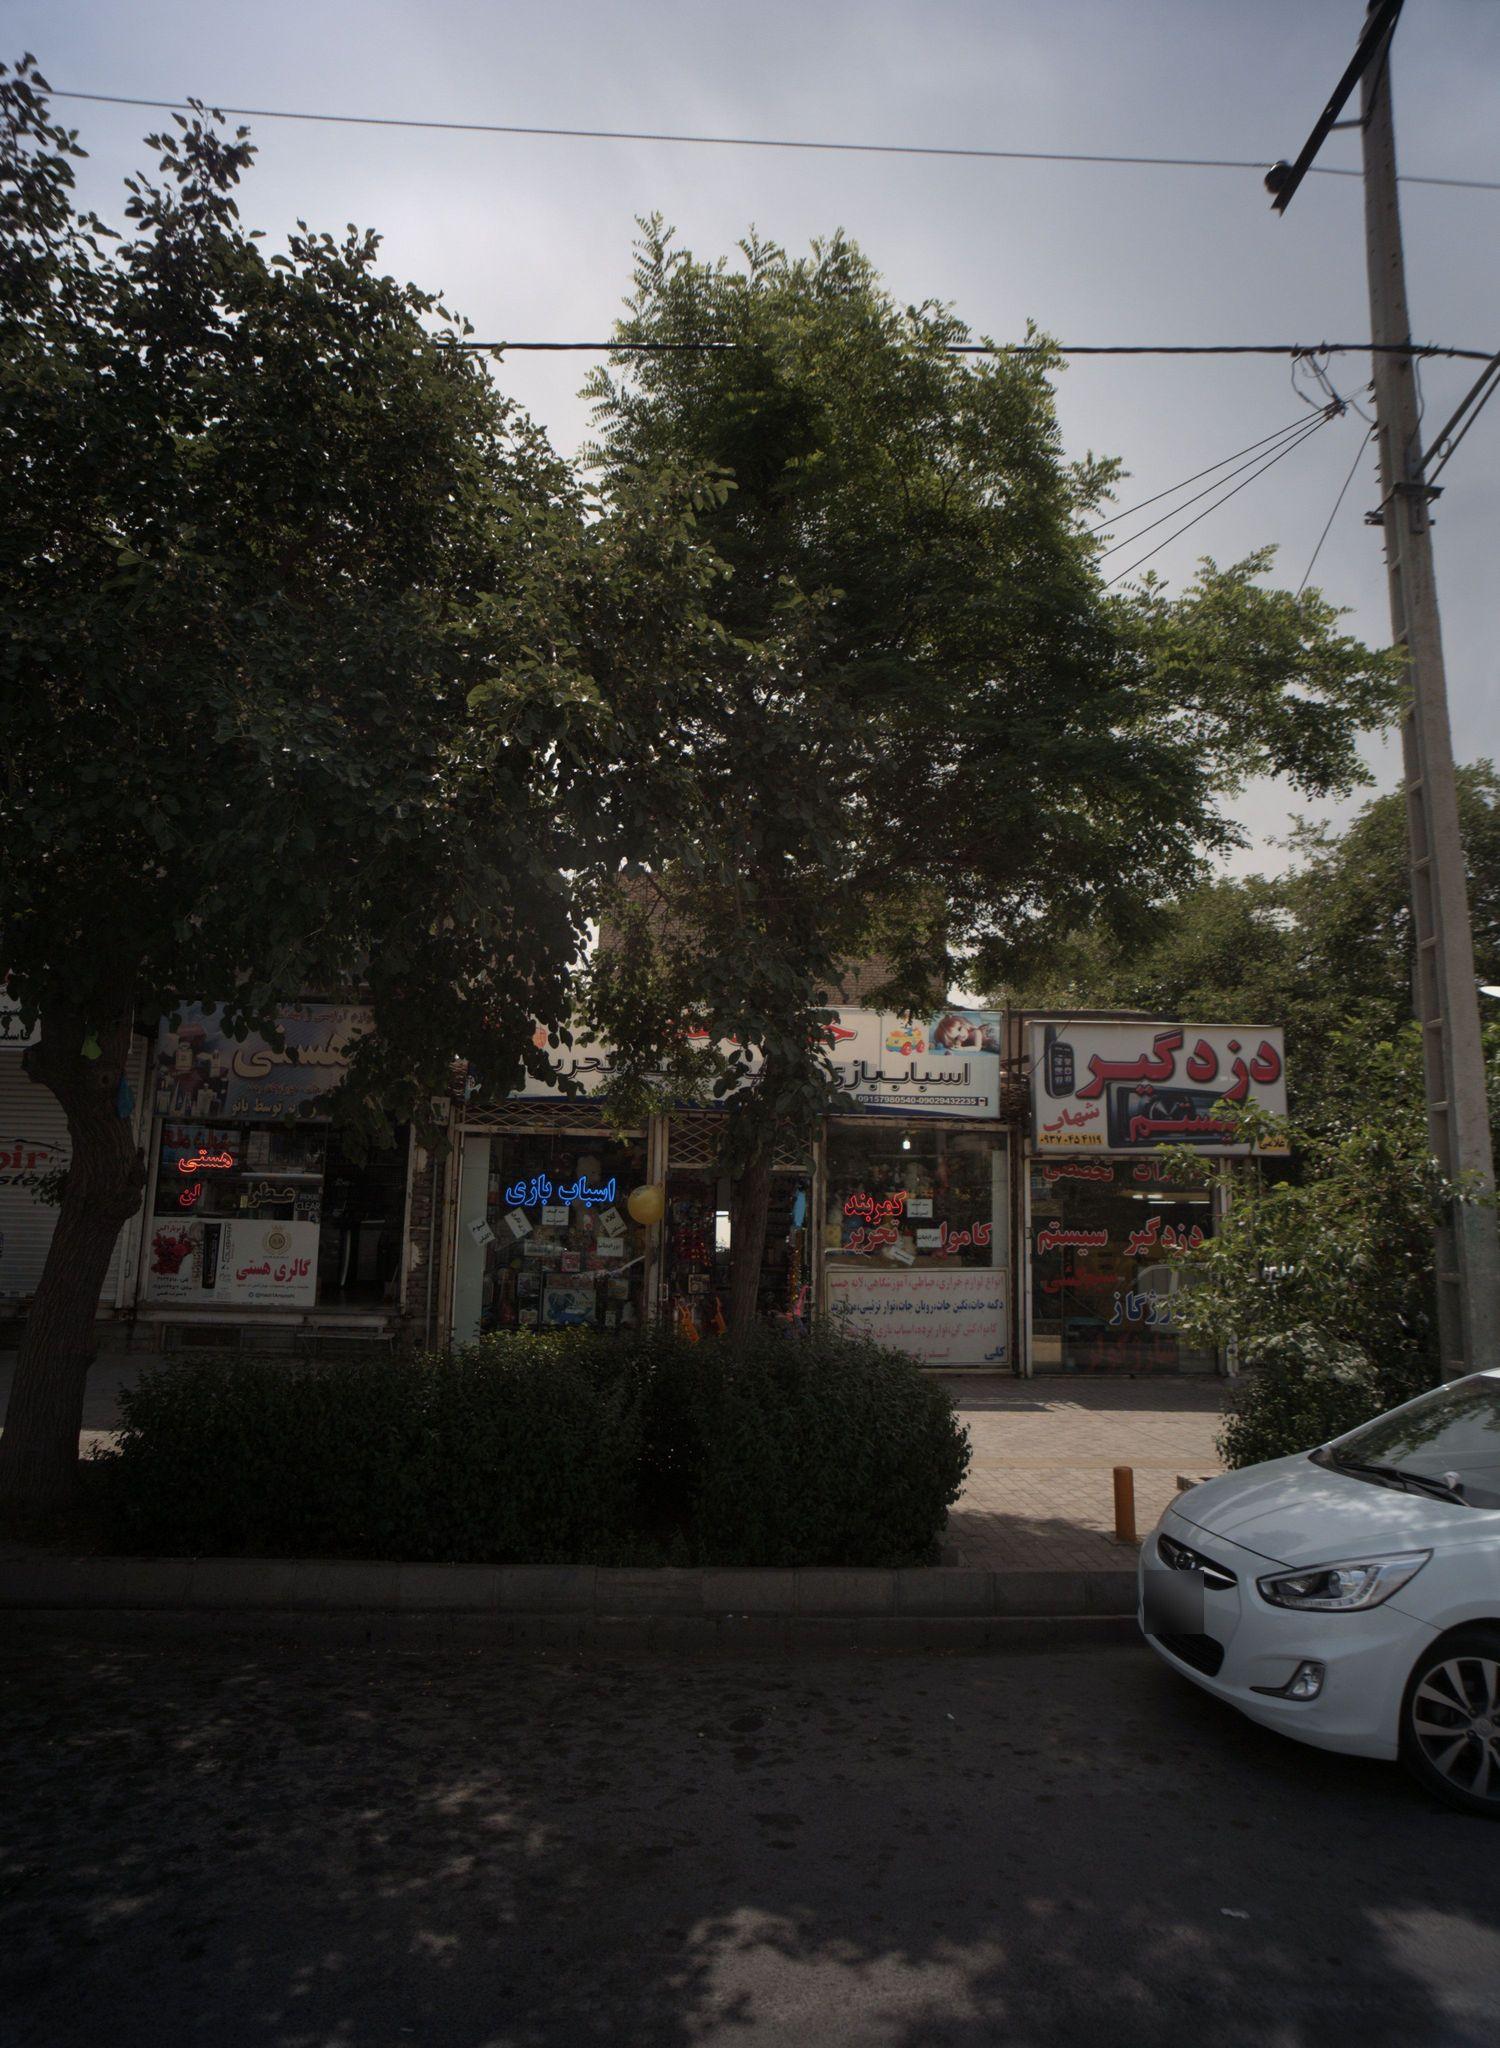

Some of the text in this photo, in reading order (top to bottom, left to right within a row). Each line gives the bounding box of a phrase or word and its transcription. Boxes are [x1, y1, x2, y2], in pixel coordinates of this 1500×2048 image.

[1075, 1028, 1282, 1100] دزدگیر
[1043, 1102, 1100, 1133] شهاب
[1129, 1101, 1239, 1146] یستم
[177, 1148, 234, 1173] هستی
[505, 1172, 616, 1208] اسباب بازی
[844, 1190, 909, 1223] کمربند
[843, 1219, 900, 1256] تحریر
[1037, 1216, 1204, 1259] دزدگیر سیستم
[235, 1259, 271, 1281] هستی
[274, 1257, 312, 1282] گالری
[1109, 1290, 1146, 1325] گاز
